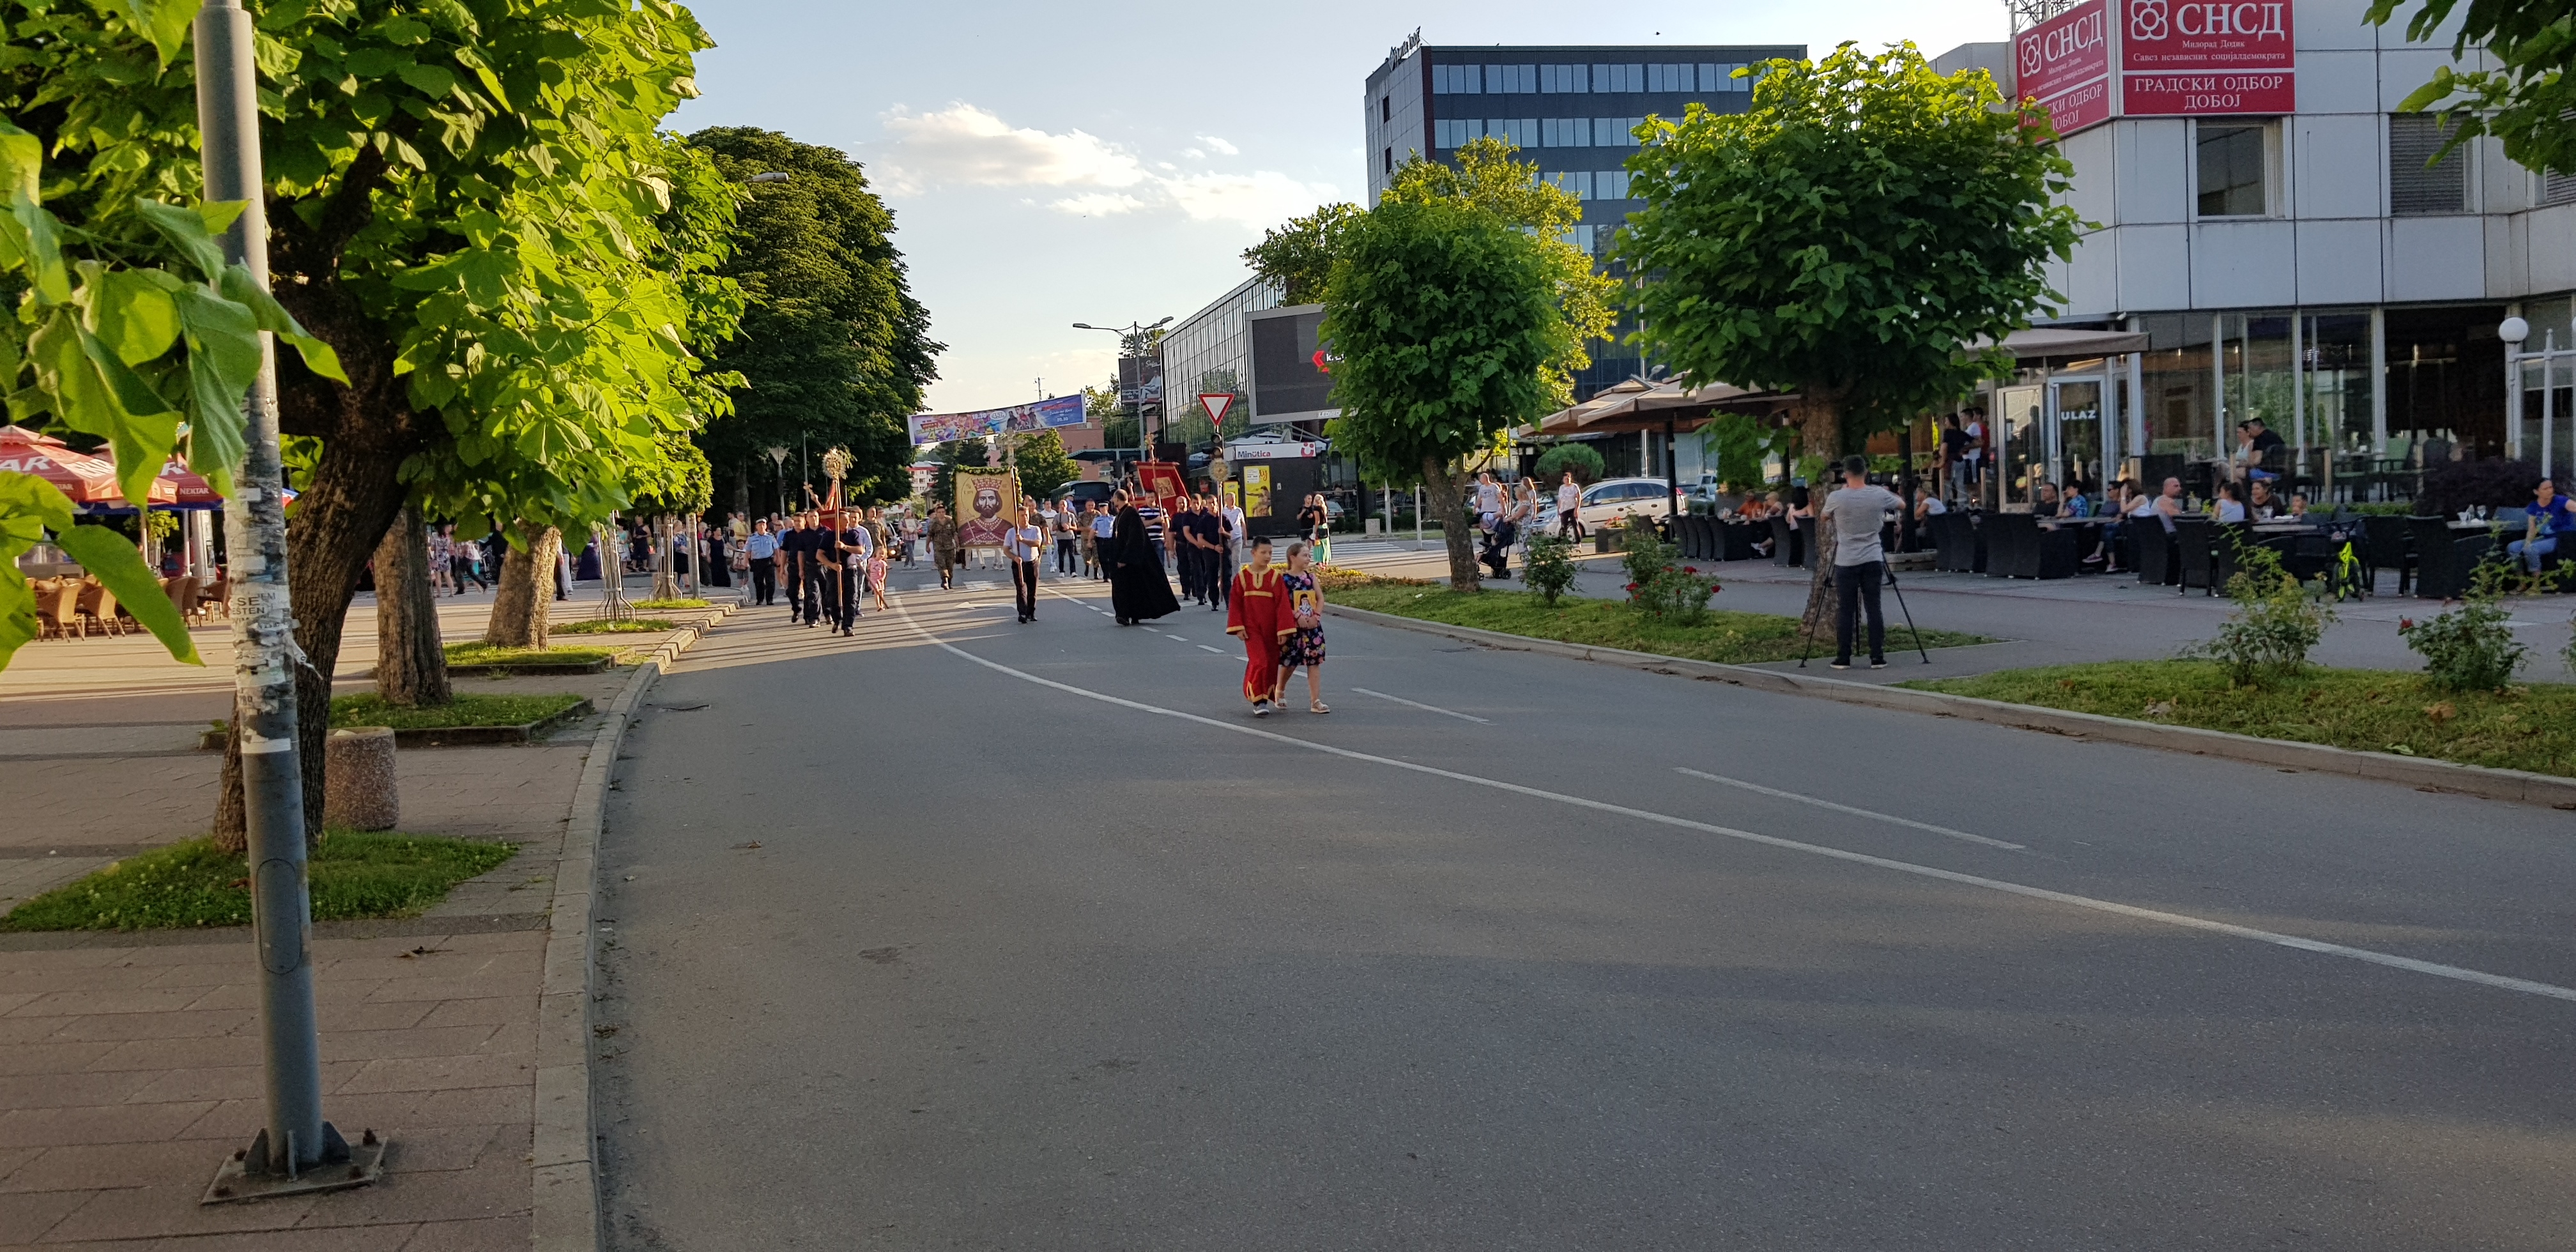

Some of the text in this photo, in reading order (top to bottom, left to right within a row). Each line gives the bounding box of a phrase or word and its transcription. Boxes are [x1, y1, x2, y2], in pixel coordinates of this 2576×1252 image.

[2176, 3, 2285, 42] СНСД
[2044, 10, 2103, 62] СНСД
[2182, 40, 2245, 49] Милорад Додик
[2133, 53, 2158, 61] Савез
[2211, 52, 2285, 62] социјалдемократа
[2135, 75, 2283, 93] ГРАДСКИ ОДБОР
[2069, 84, 2102, 107] ОДБОР
[2184, 94, 2241, 111] ДОБОЈ
[2061, 410, 2096, 420] ULAZ
[237, 597, 260, 606] SE
